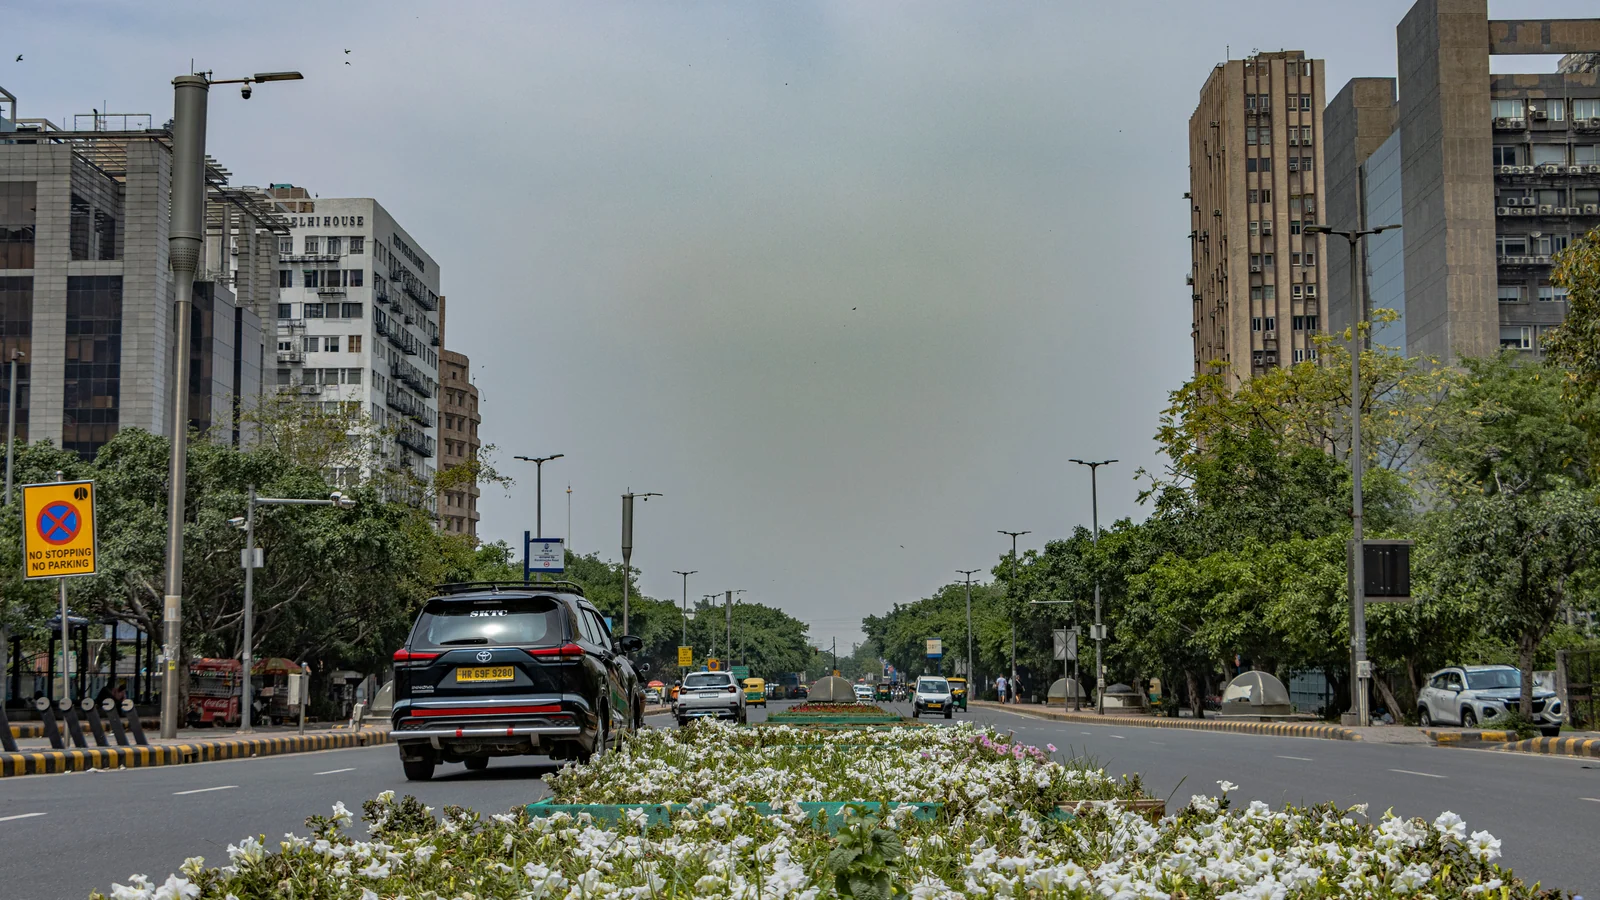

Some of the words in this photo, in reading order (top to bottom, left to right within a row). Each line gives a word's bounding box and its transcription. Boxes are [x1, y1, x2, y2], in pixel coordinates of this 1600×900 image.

[323, 216, 364, 227] HOUSE
[29, 551, 43, 560] NO
[45, 548, 91, 558] STOPPING
[32, 562, 46, 571] NO
[48, 559, 89, 569] PARKING
[461, 670, 473, 679] HR
[474, 669, 490, 678] 69F
[491, 668, 513, 677] 9280
